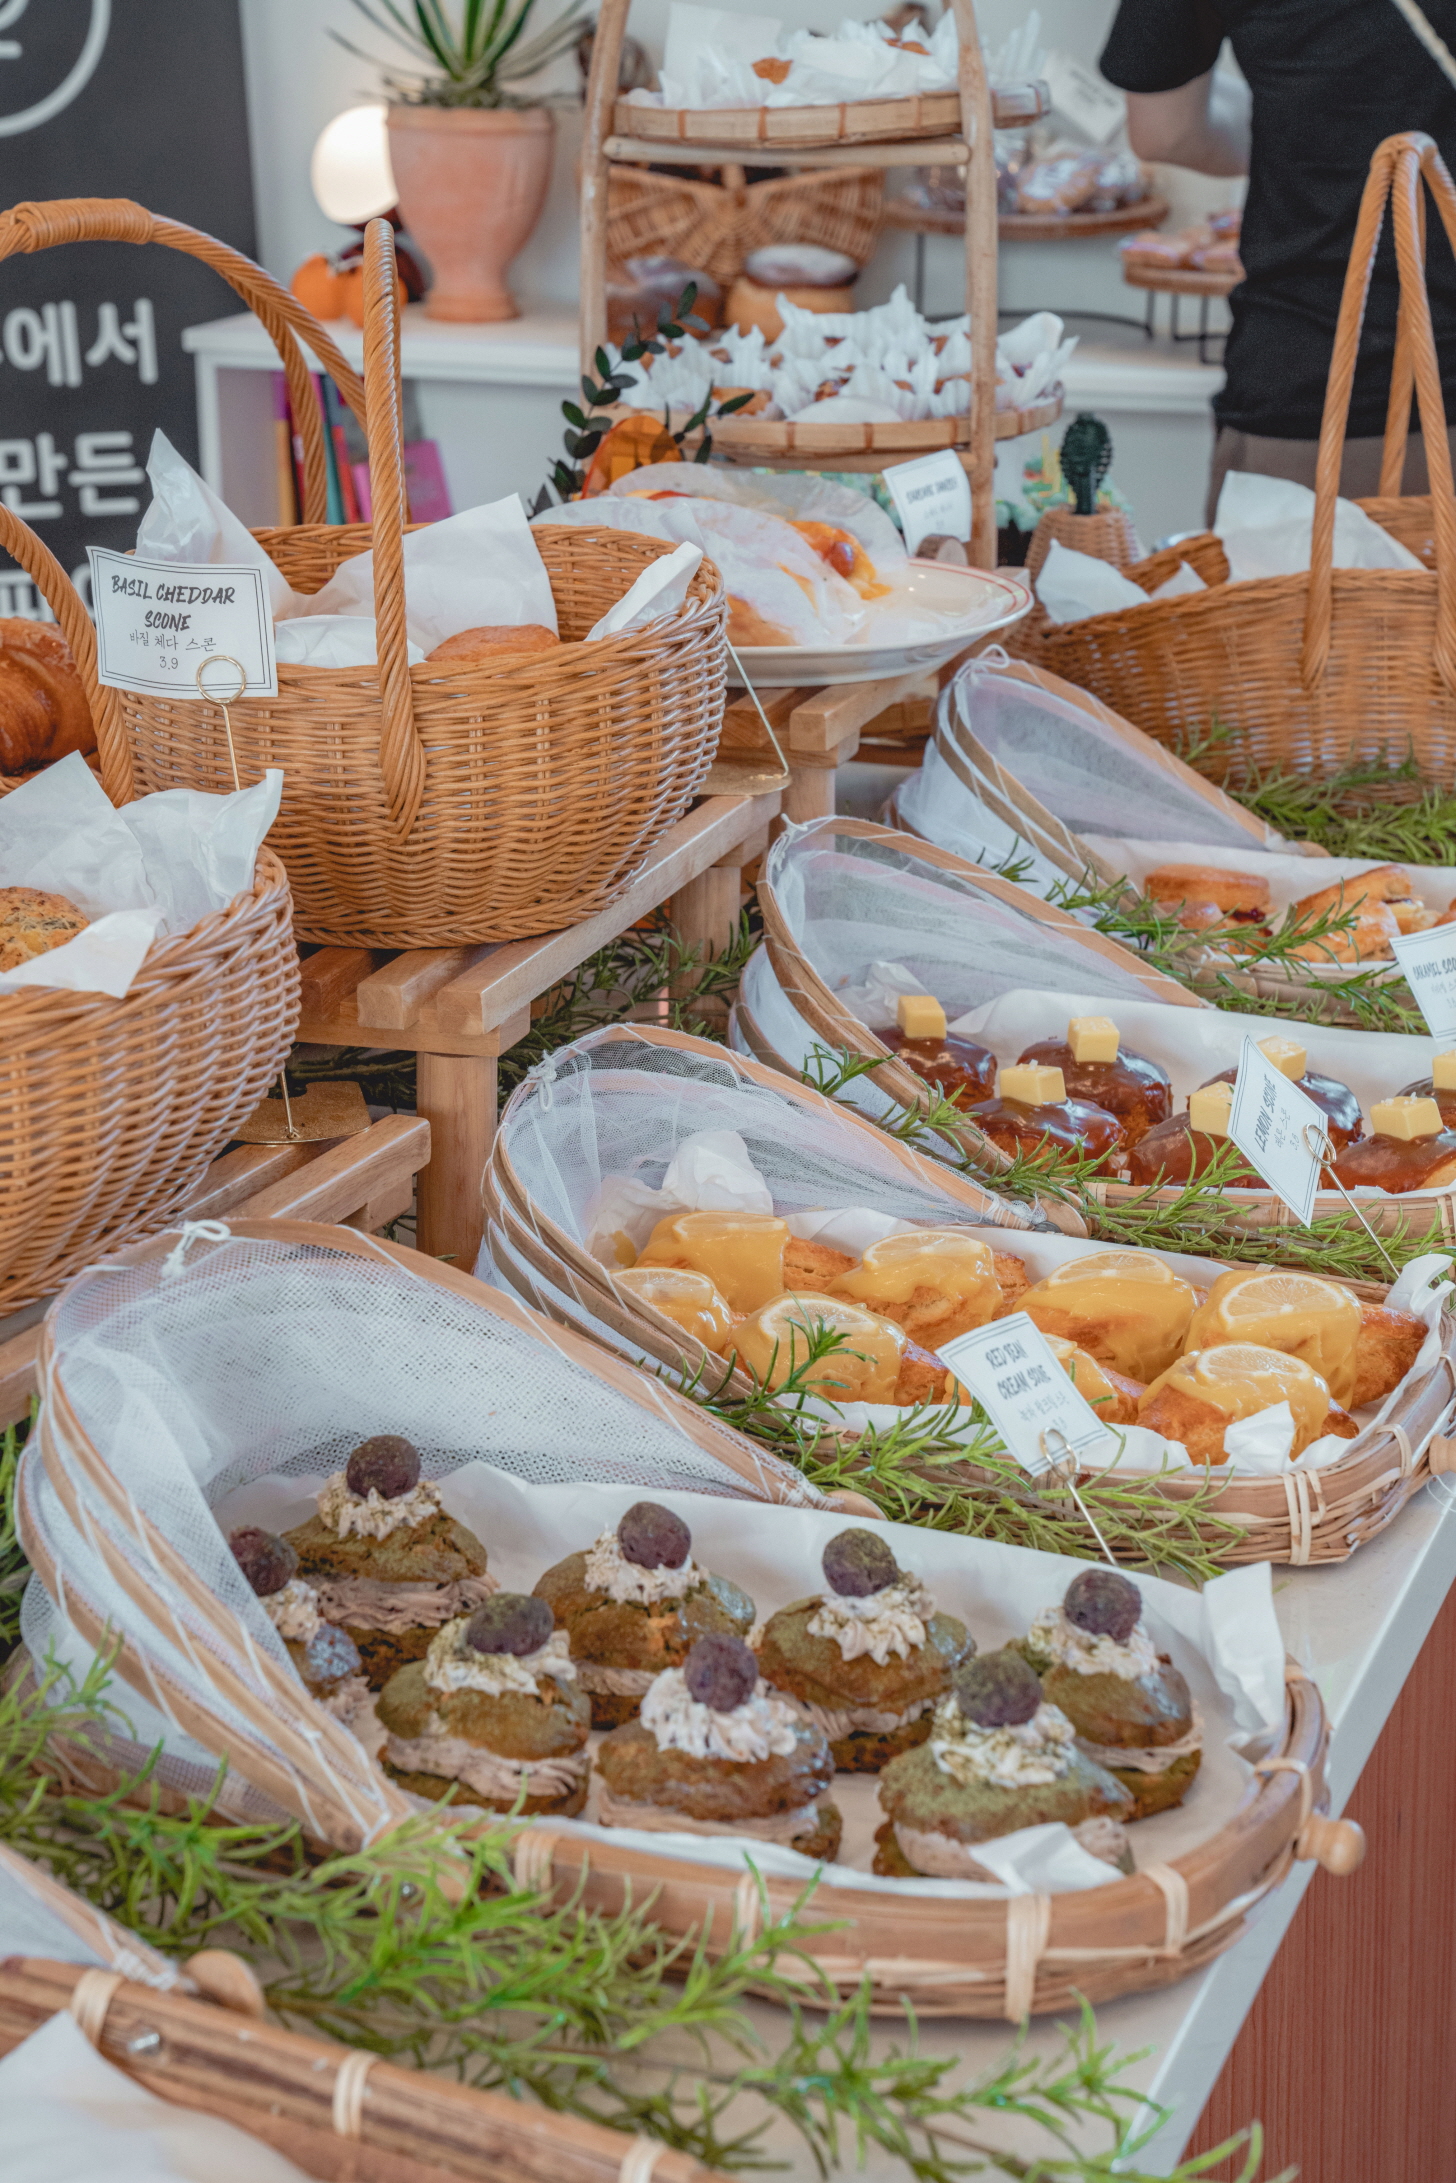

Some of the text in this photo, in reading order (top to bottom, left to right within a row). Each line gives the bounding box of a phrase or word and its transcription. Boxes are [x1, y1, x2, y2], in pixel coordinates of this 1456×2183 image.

[0, 299, 159, 388] 에서
[0, 431, 145, 519] 만든
[111, 574, 152, 600] BASIL
[156, 583, 236, 605] CHEDDAR
[144, 610, 192, 632] SCONE
[130, 628, 217, 652] 바질 체다 스콘
[159, 655, 179, 670] 3.9
[1254, 1073, 1278, 1153] LEMON SCONE
[985, 1339, 1029, 1371] RED BEAN
[997, 1370, 1033, 1400] CREAM
